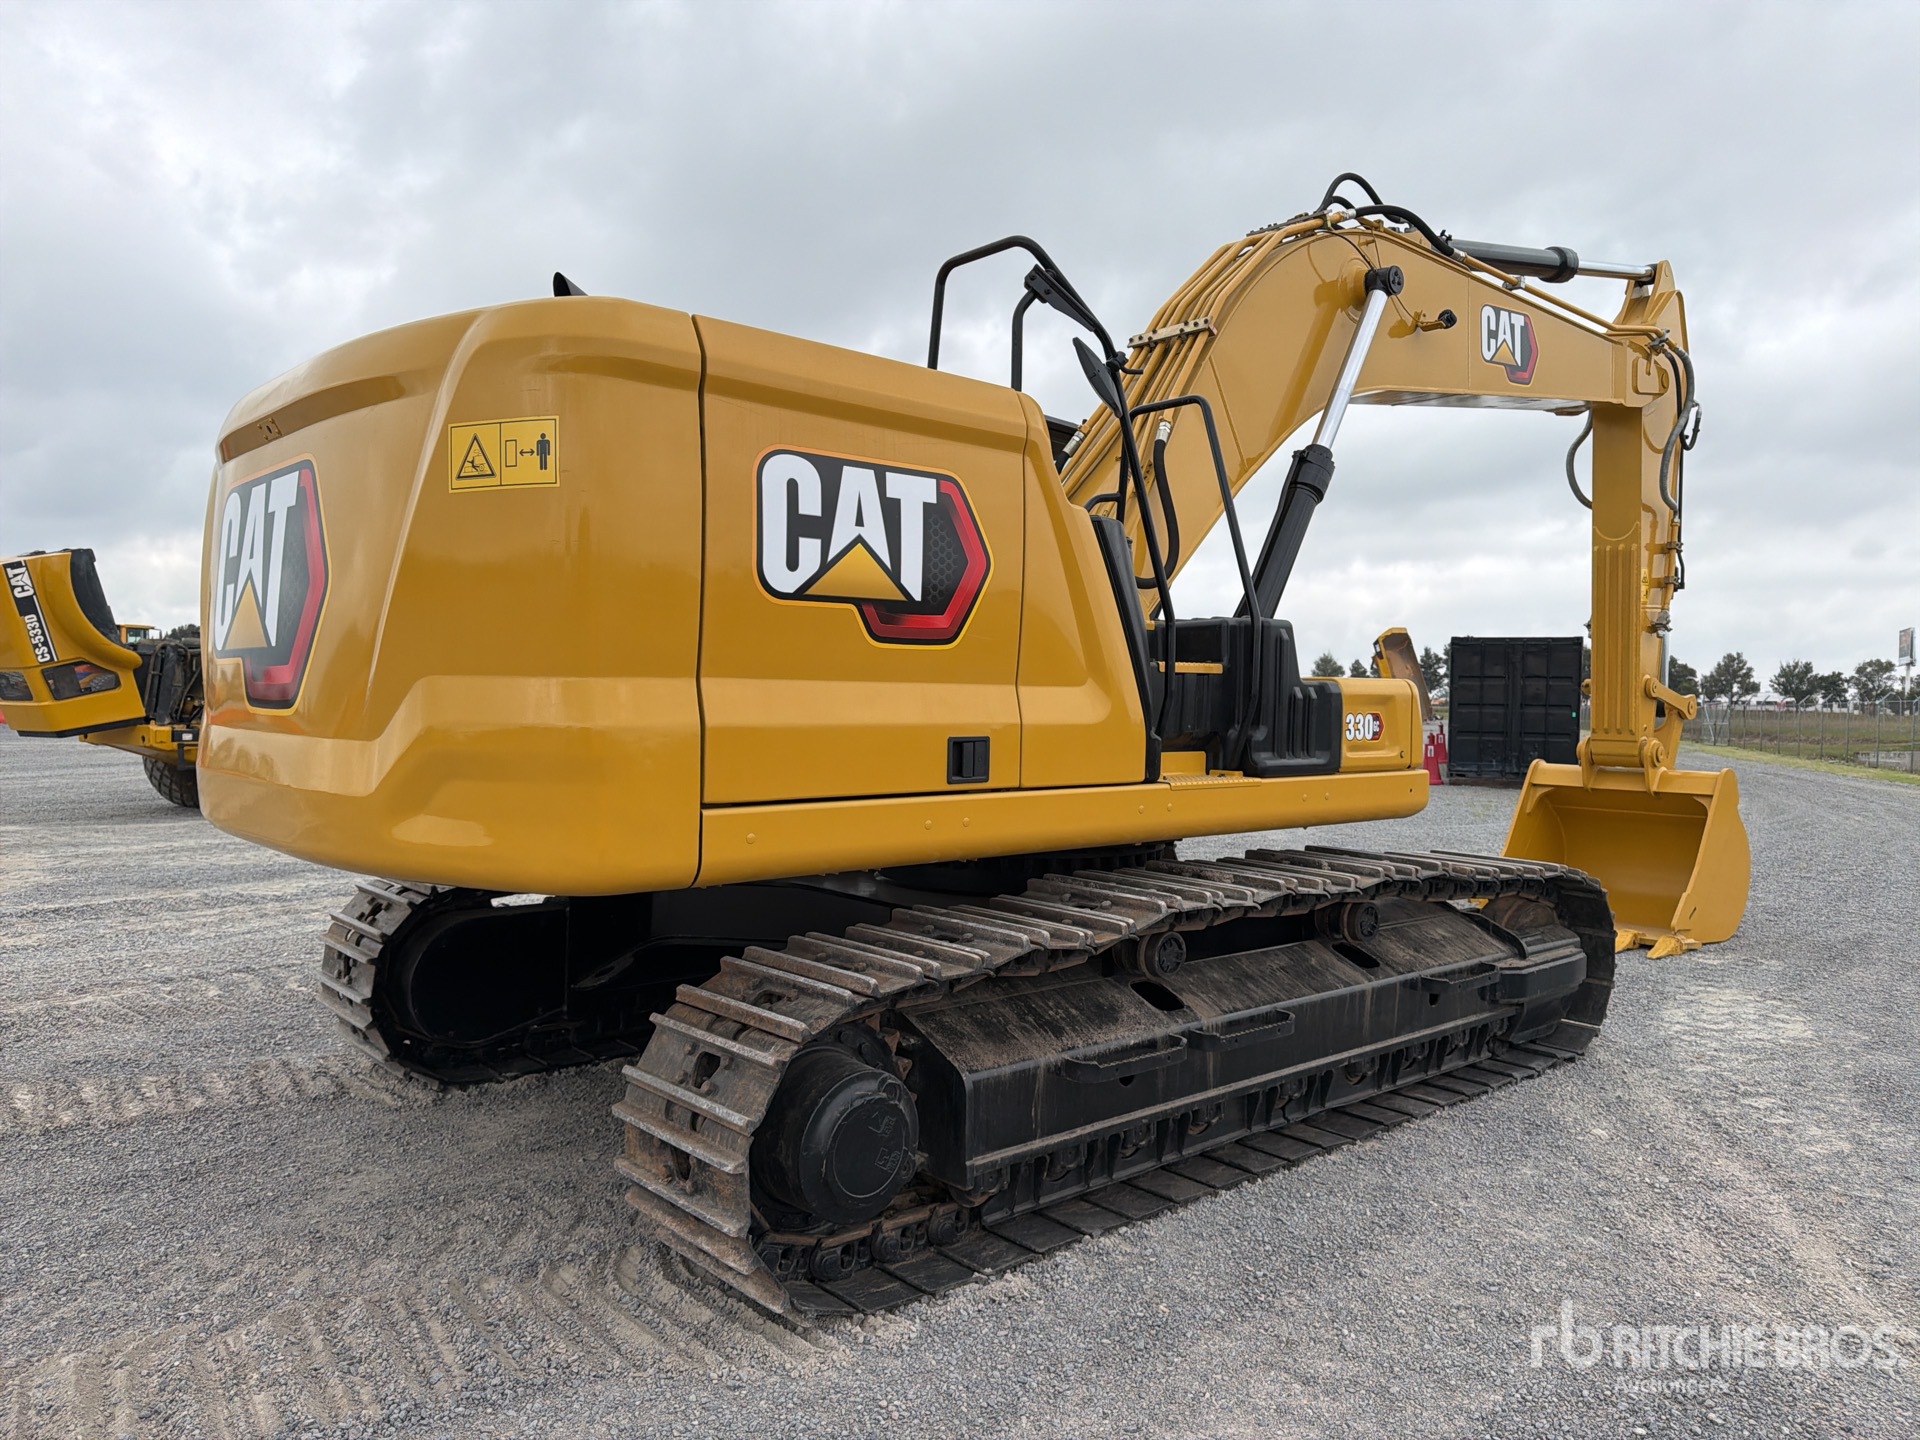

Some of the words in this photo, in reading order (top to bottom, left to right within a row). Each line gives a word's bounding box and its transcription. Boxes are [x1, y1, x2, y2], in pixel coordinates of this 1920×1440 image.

[1481, 305, 1525, 367] CAT
[761, 453, 937, 602] CAT
[6, 566, 35, 599] CAT
[214, 470, 300, 651] CAT
[24, 613, 51, 663] CS-533D
[1345, 713, 1374, 741] 330
